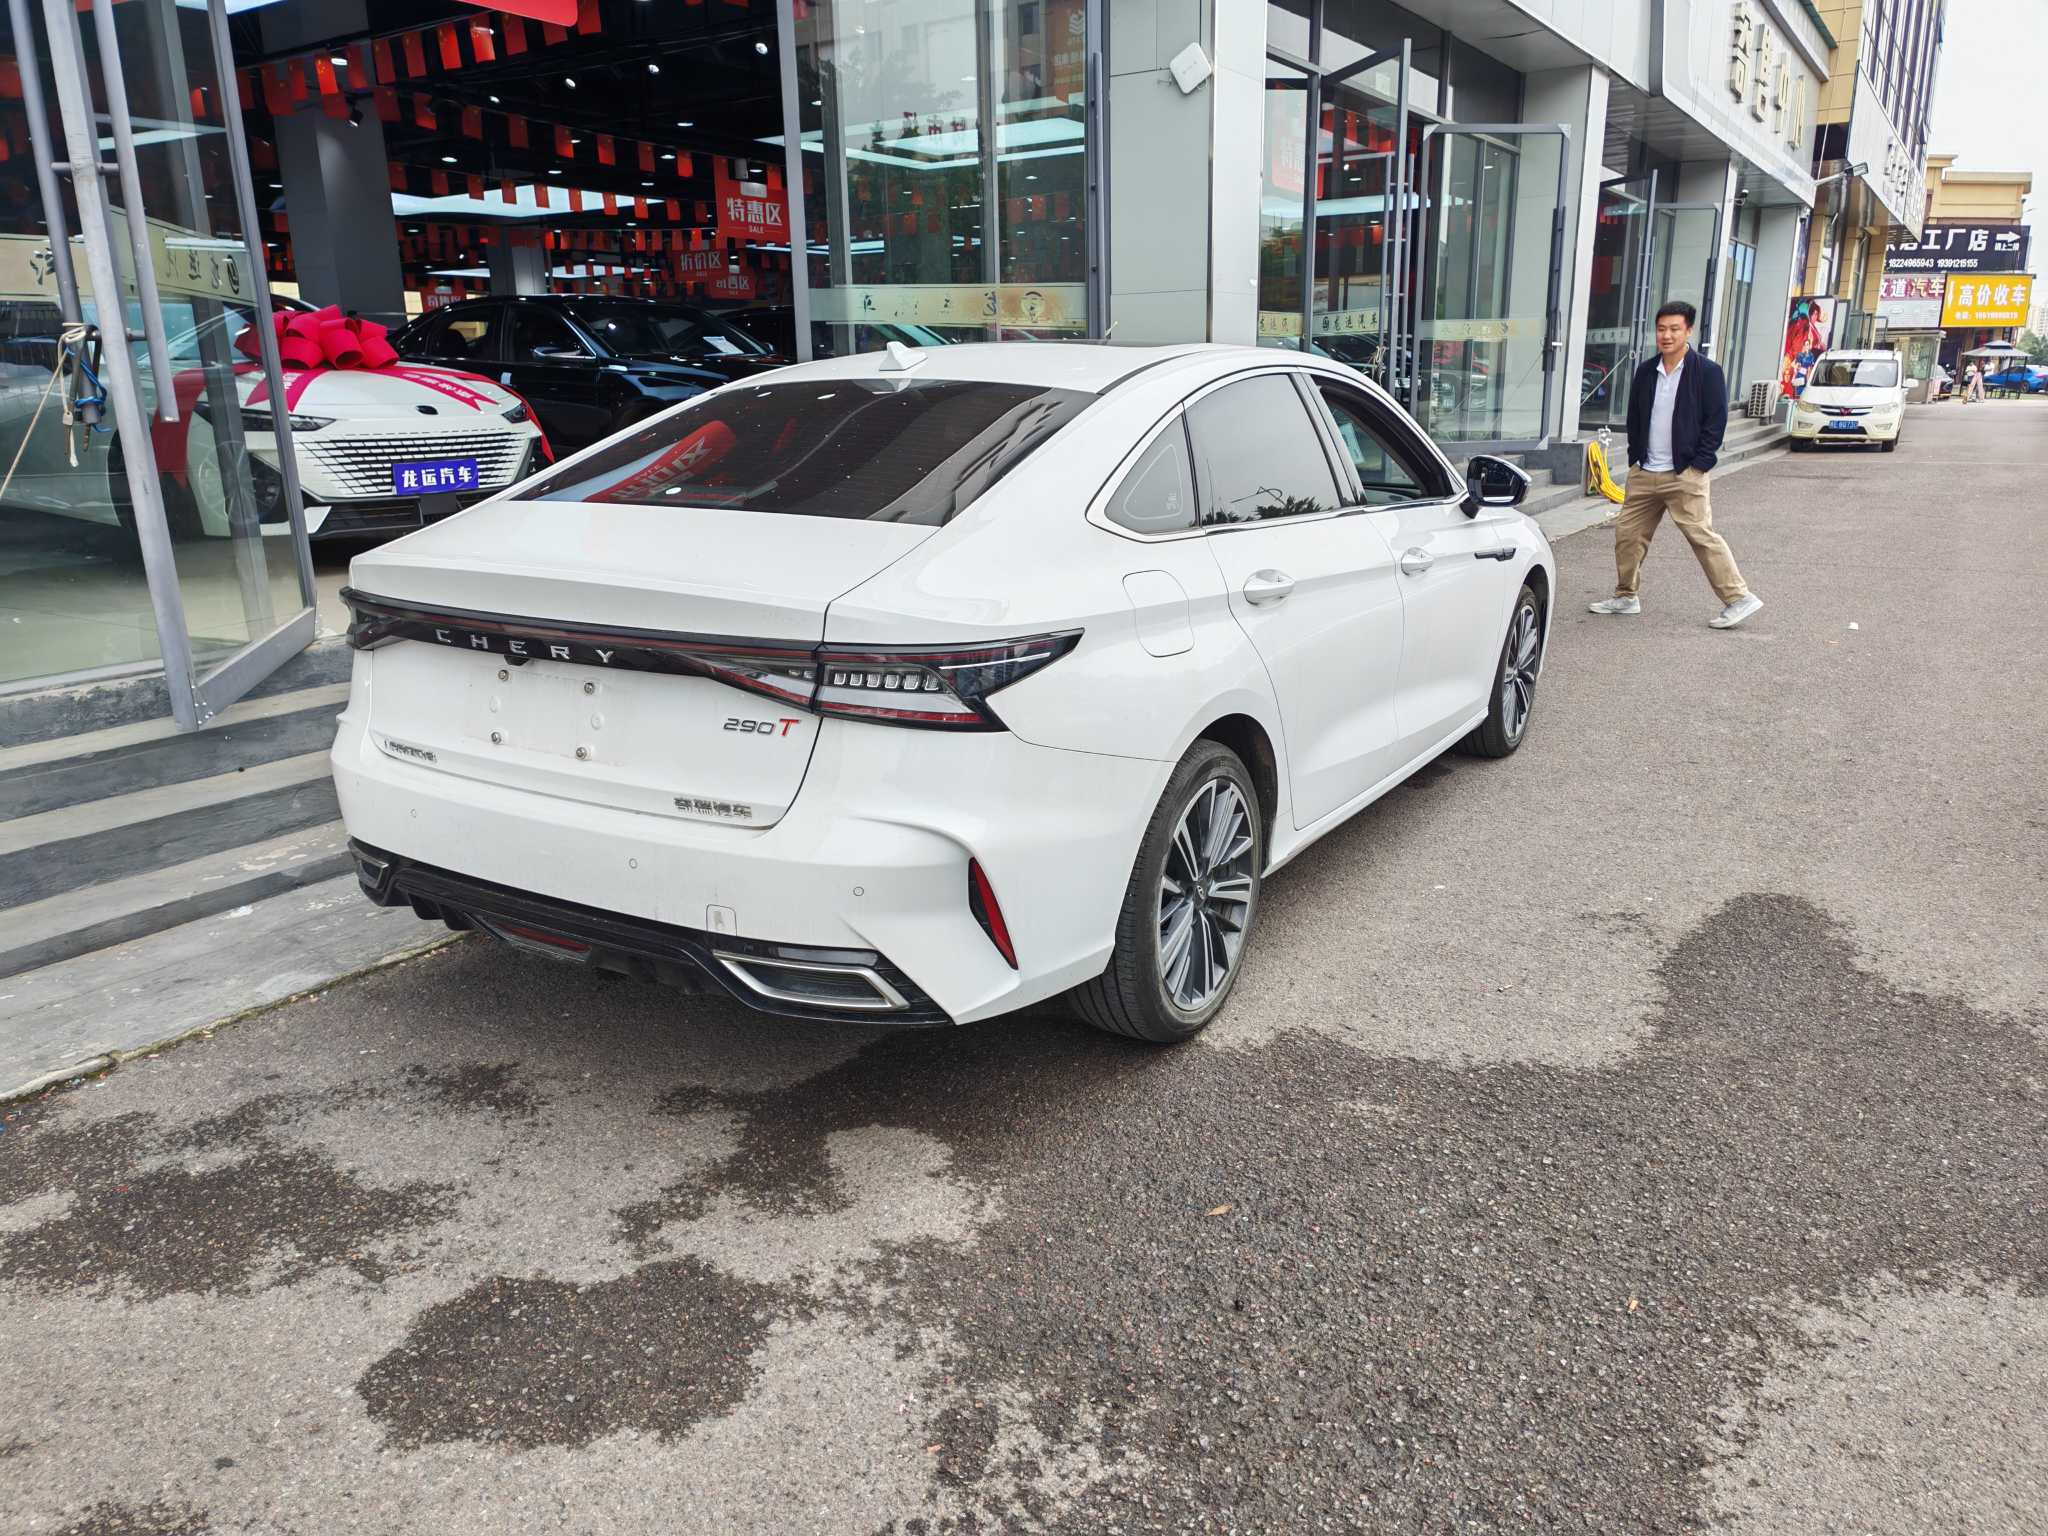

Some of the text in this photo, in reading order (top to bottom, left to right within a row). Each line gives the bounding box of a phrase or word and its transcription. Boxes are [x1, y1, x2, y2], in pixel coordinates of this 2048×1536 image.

[727, 198, 782, 226] 特惠区
[1959, 284, 2026, 307] 高价收车
[402, 464, 473, 488] 龙运汽车
[435, 629, 614, 663] CHERY
[723, 717, 799, 737] 290T
